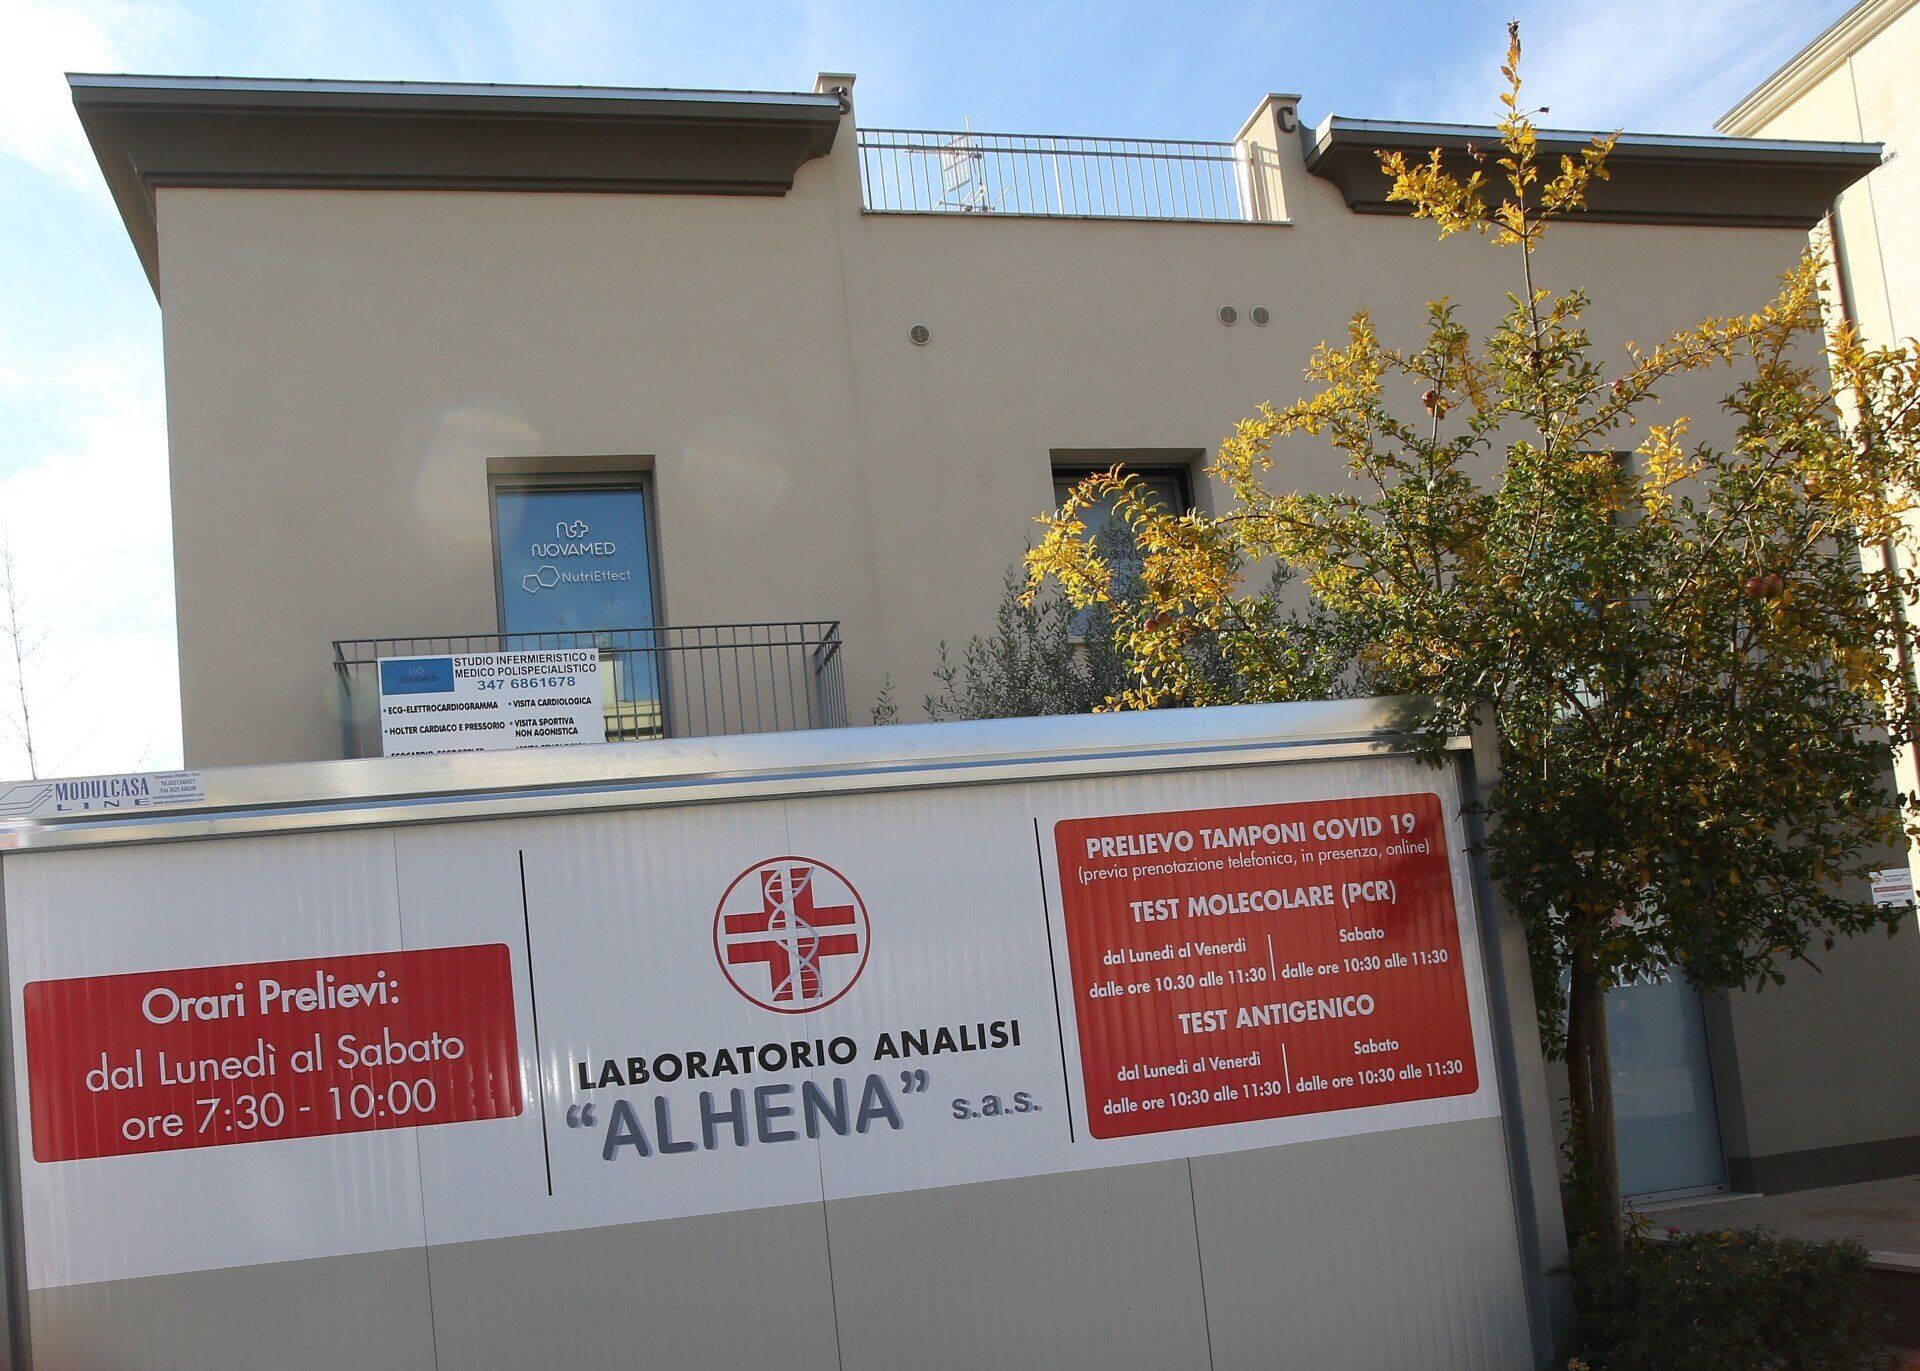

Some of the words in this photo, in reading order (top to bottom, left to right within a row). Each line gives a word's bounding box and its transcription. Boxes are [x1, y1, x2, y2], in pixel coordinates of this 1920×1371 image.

[1277, 106, 1296, 133] C
[532, 542, 616, 557] NOVAMED
[562, 570, 632, 583] NutriEffect
[454, 656, 493, 667] STUDIO
[496, 652, 587, 665] INFERMIERISTICO
[455, 667, 495, 678] MEDICO
[498, 663, 597, 676] POLISPECIALISTICO
[478, 679, 504, 690] 347
[510, 676, 576, 689] 6861678
[513, 699, 536, 708] VISITA
[537, 696, 592, 706] CARDIOLOGICA
[389, 726, 418, 735] HOLTER
[419, 724, 457, 734] CARDIACO
[459, 723, 463, 731] E
[465, 721, 506, 731] PRESSORIO
[514, 718, 538, 728] VISITA
[539, 717, 574, 726] SPORTIVA
[515, 729, 533, 738] NON
[534, 727, 578, 737] AGONISTICA
[55, 777, 150, 801] MODULCASA
[57, 797, 150, 812] LINE
[1086, 830, 1193, 859] PRELIEVO
[1199, 822, 1306, 851] TAMPONI
[1313, 817, 1382, 840] COVID
[1390, 813, 1415, 834] 19
[1079, 864, 1128, 885] (previa
[1132, 857, 1224, 881] prenotazione
[1228, 850, 1297, 868] telefonica,
[1301, 849, 1314, 862] in
[1318, 847, 1382, 865] presenza,
[1386, 838, 1429, 855] online)
[1130, 898, 1179, 922] TEST
[1188, 885, 1334, 918] MOLECOLARE
[1342, 879, 1396, 909] (PCR)
[1339, 926, 1384, 942] Sabato
[1103, 948, 1125, 965] dal
[1129, 944, 1174, 963] Lunedì
[1178, 942, 1191, 958] al
[1194, 938, 1246, 956] Venerdì
[1281, 962, 1314, 979] dalle
[1318, 964, 1339, 975] ore
[1344, 956, 1380, 972] 10:30
[1384, 953, 1407, 968] alle
[1412, 949, 1448, 965] 11:30
[1089, 981, 1123, 998] dalle
[1128, 983, 1150, 994] ore
[1155, 974, 1195, 991] 10.30
[1199, 971, 1224, 987] alle
[1228, 967, 1266, 984] 11:30
[142, 982, 245, 1024] Orari
[259, 970, 399, 1015] Prelievi:
[1178, 1009, 1228, 1034] TEST
[1236, 994, 1374, 1028] ANTIGENICO
[86, 1049, 143, 1092] dal
[159, 1038, 276, 1085] Lunedì
[291, 1033, 322, 1073] al
[338, 1027, 464, 1069] Sabato
[578, 1036, 857, 1090] LABORATORIO
[873, 1020, 1020, 1061] ANALISI
[1354, 1038, 1399, 1055] Sabato
[1117, 1064, 1139, 1081] dal
[1143, 1059, 1188, 1078] Lunedì
[1192, 1057, 1206, 1073] al
[1208, 1051, 1261, 1070] Venerdì
[1296, 1075, 1328, 1092] dalle
[1332, 1076, 1354, 1088] ore
[1358, 1067, 1395, 1085] 10:30
[1399, 1064, 1422, 1080] alle
[1426, 1060, 1463, 1076] 11:30
[122, 1114, 183, 1140] ore
[196, 1092, 284, 1133] 7:30
[329, 1076, 436, 1120] 10:00
[952, 1091, 1043, 1120] s.a.s.
[1103, 1097, 1138, 1115] dalle
[1142, 1098, 1165, 1110] ore
[1170, 1089, 1209, 1107] 10:30
[1213, 1085, 1238, 1102] alle
[1243, 1080, 1281, 1098] 11:30
